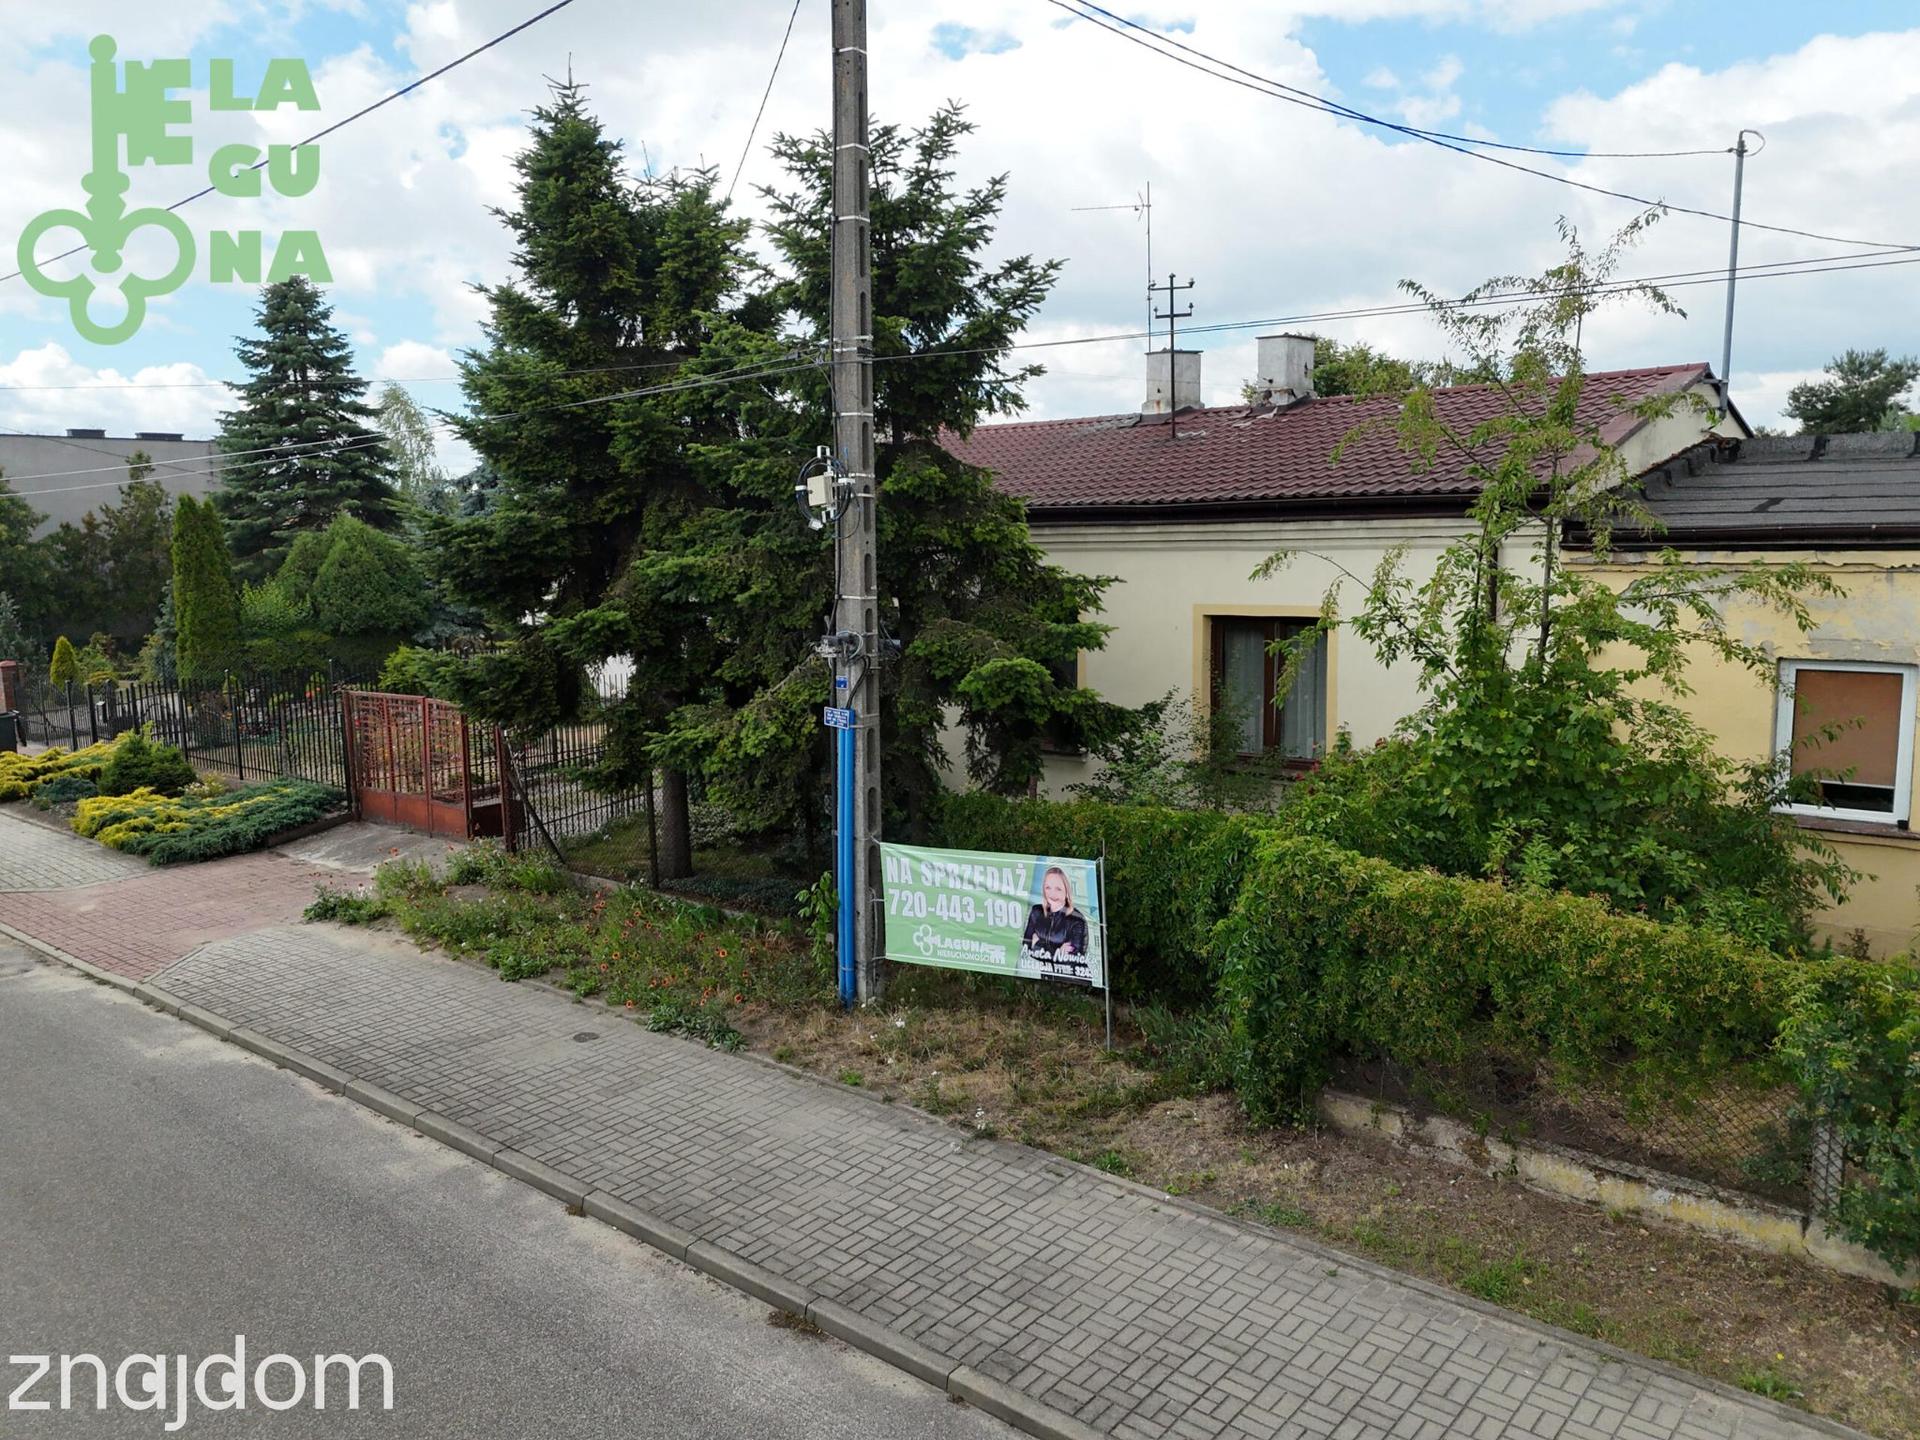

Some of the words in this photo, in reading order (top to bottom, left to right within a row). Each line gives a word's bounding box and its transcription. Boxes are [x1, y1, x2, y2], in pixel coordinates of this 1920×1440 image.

[884, 856, 913, 884] NA
[920, 861, 1028, 896] SPRZEDAŻ
[887, 888, 1023, 929] 720-443-190
[1020, 944, 1052, 960] Aneta
